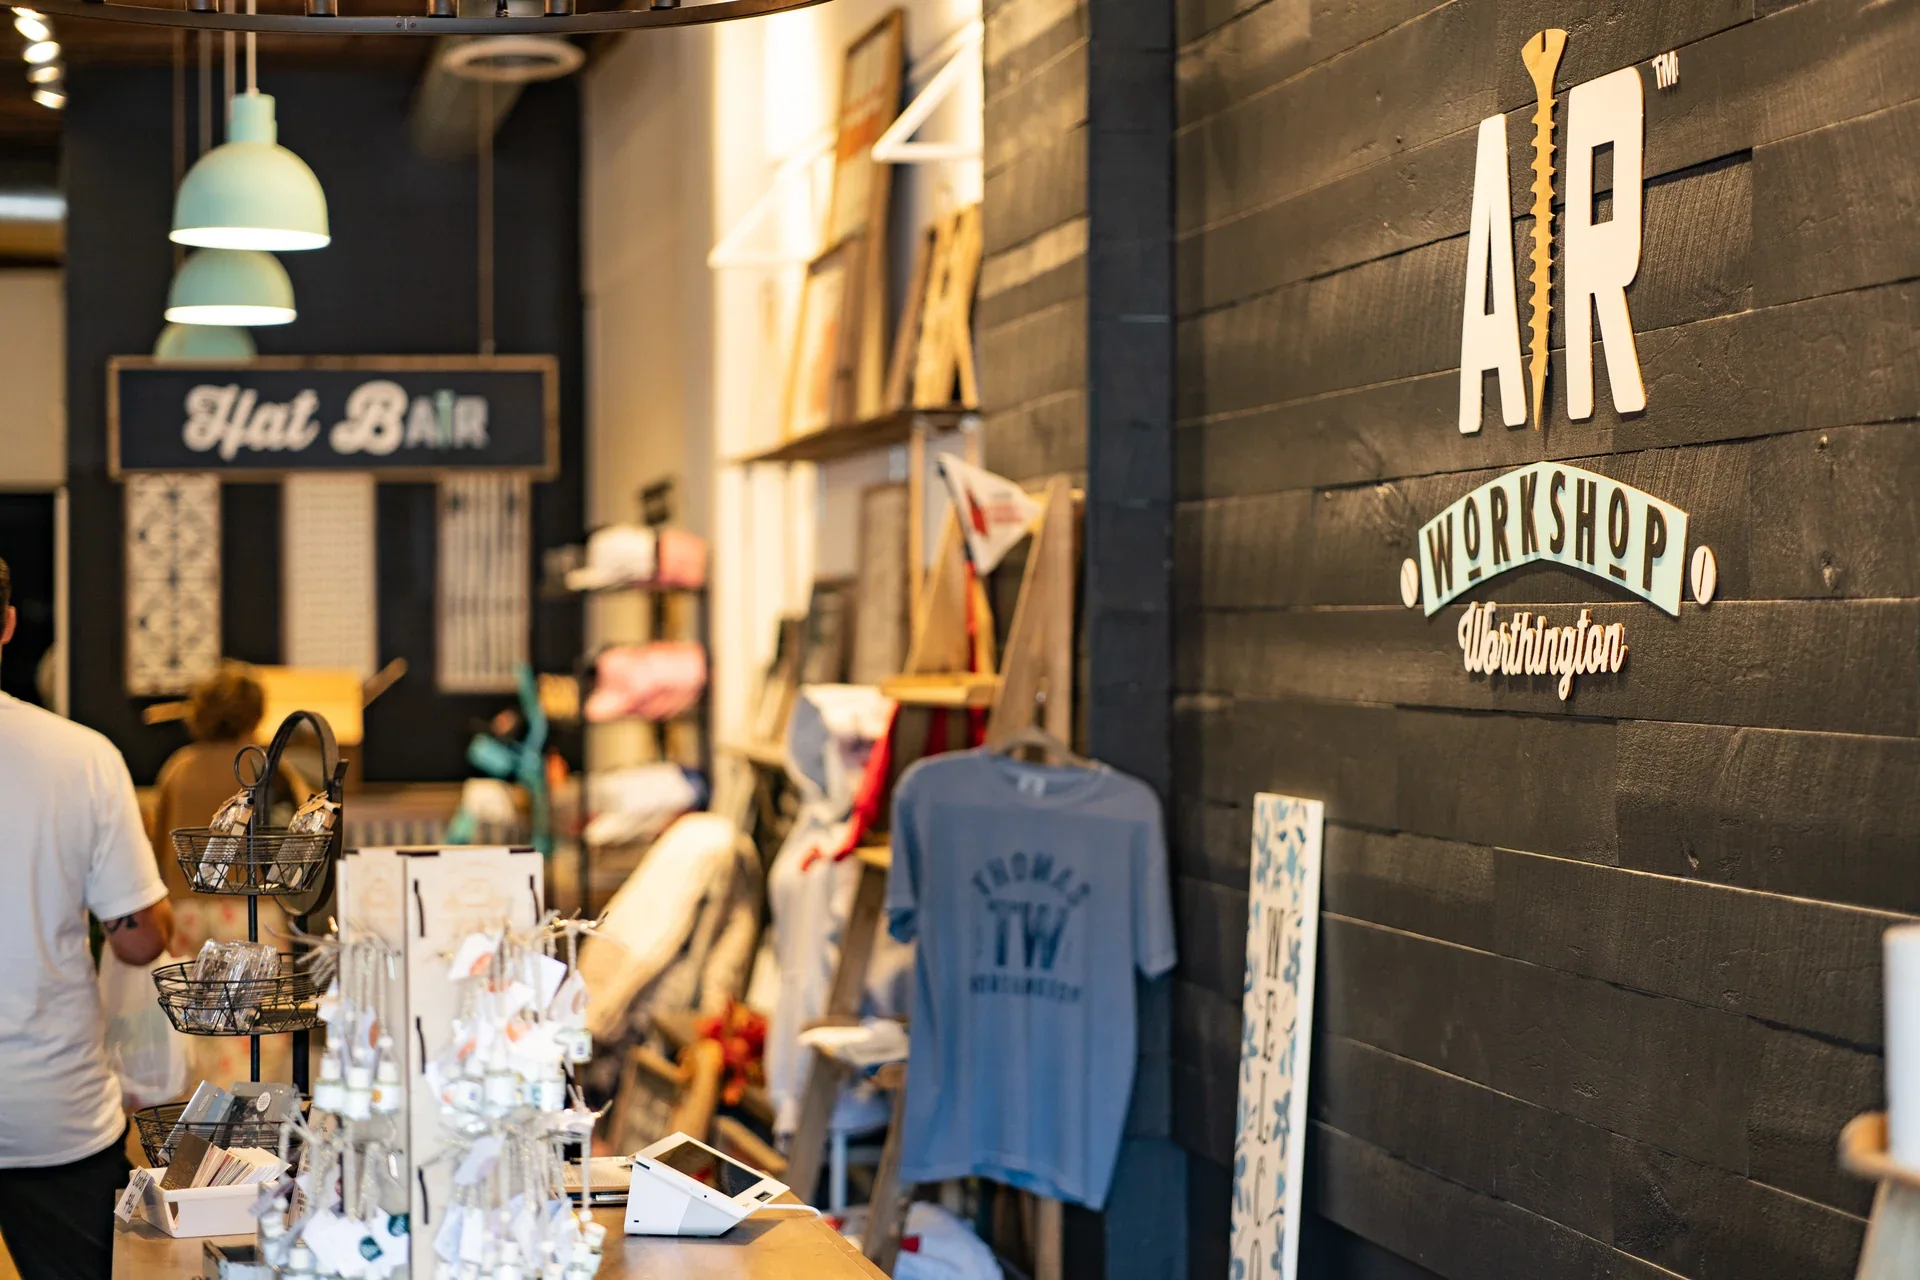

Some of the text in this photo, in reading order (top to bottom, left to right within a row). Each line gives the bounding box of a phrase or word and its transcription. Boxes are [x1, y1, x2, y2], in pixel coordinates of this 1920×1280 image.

[182, 383, 320, 461] Hat
[1426, 469, 1668, 599] WORKSHOP
[1457, 601, 1628, 701] Worthington
[987, 900, 1069, 970] TW
